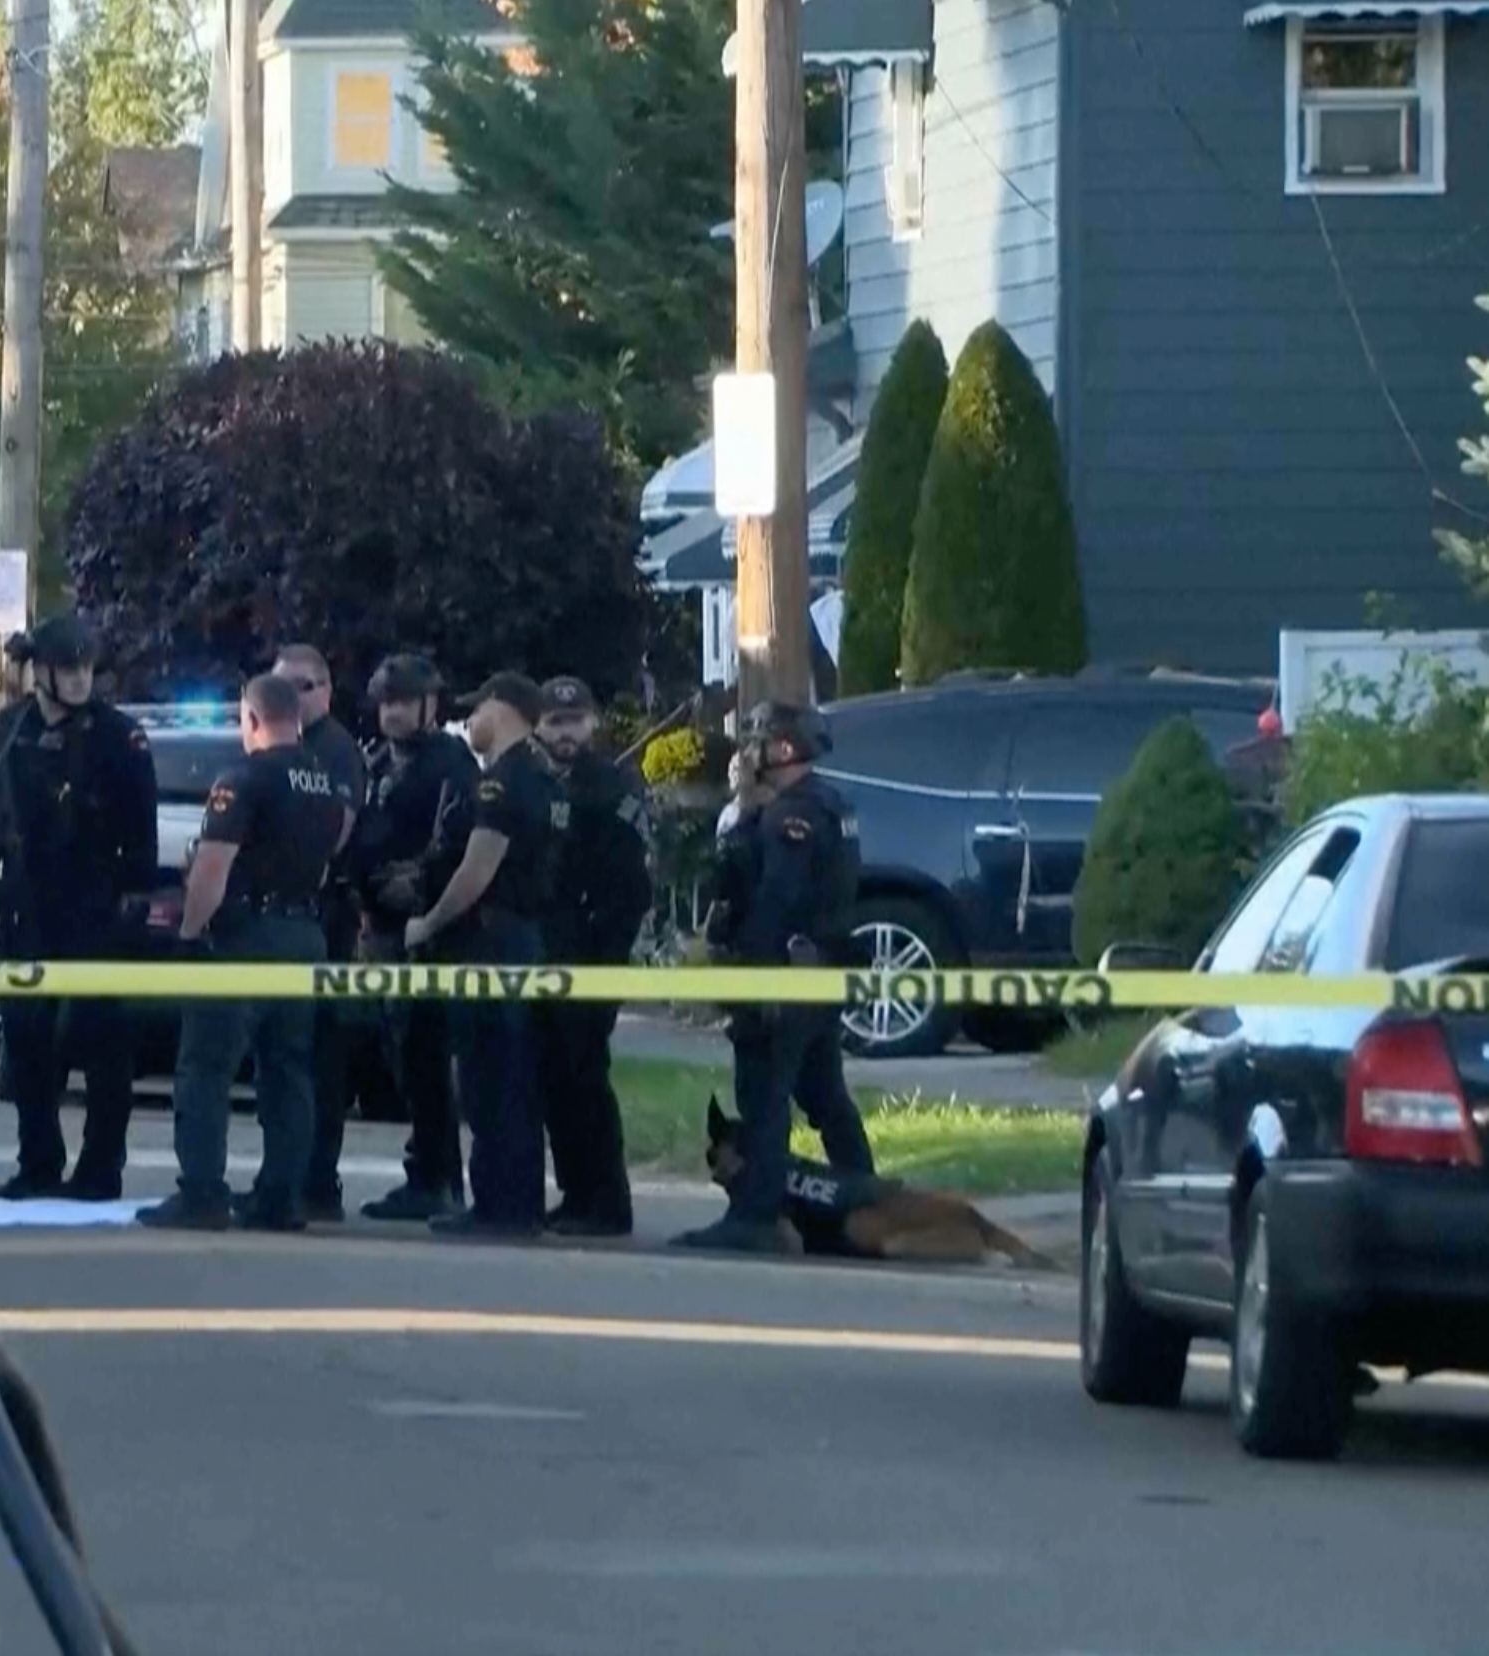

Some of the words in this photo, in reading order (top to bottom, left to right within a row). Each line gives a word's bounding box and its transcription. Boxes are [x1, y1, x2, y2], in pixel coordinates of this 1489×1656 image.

[287, 767, 332, 796] POLICE
[312, 967, 573, 996] CAUTION
[845, 972, 1113, 1005] CAUTION
[787, 1170, 839, 1206] LICE
